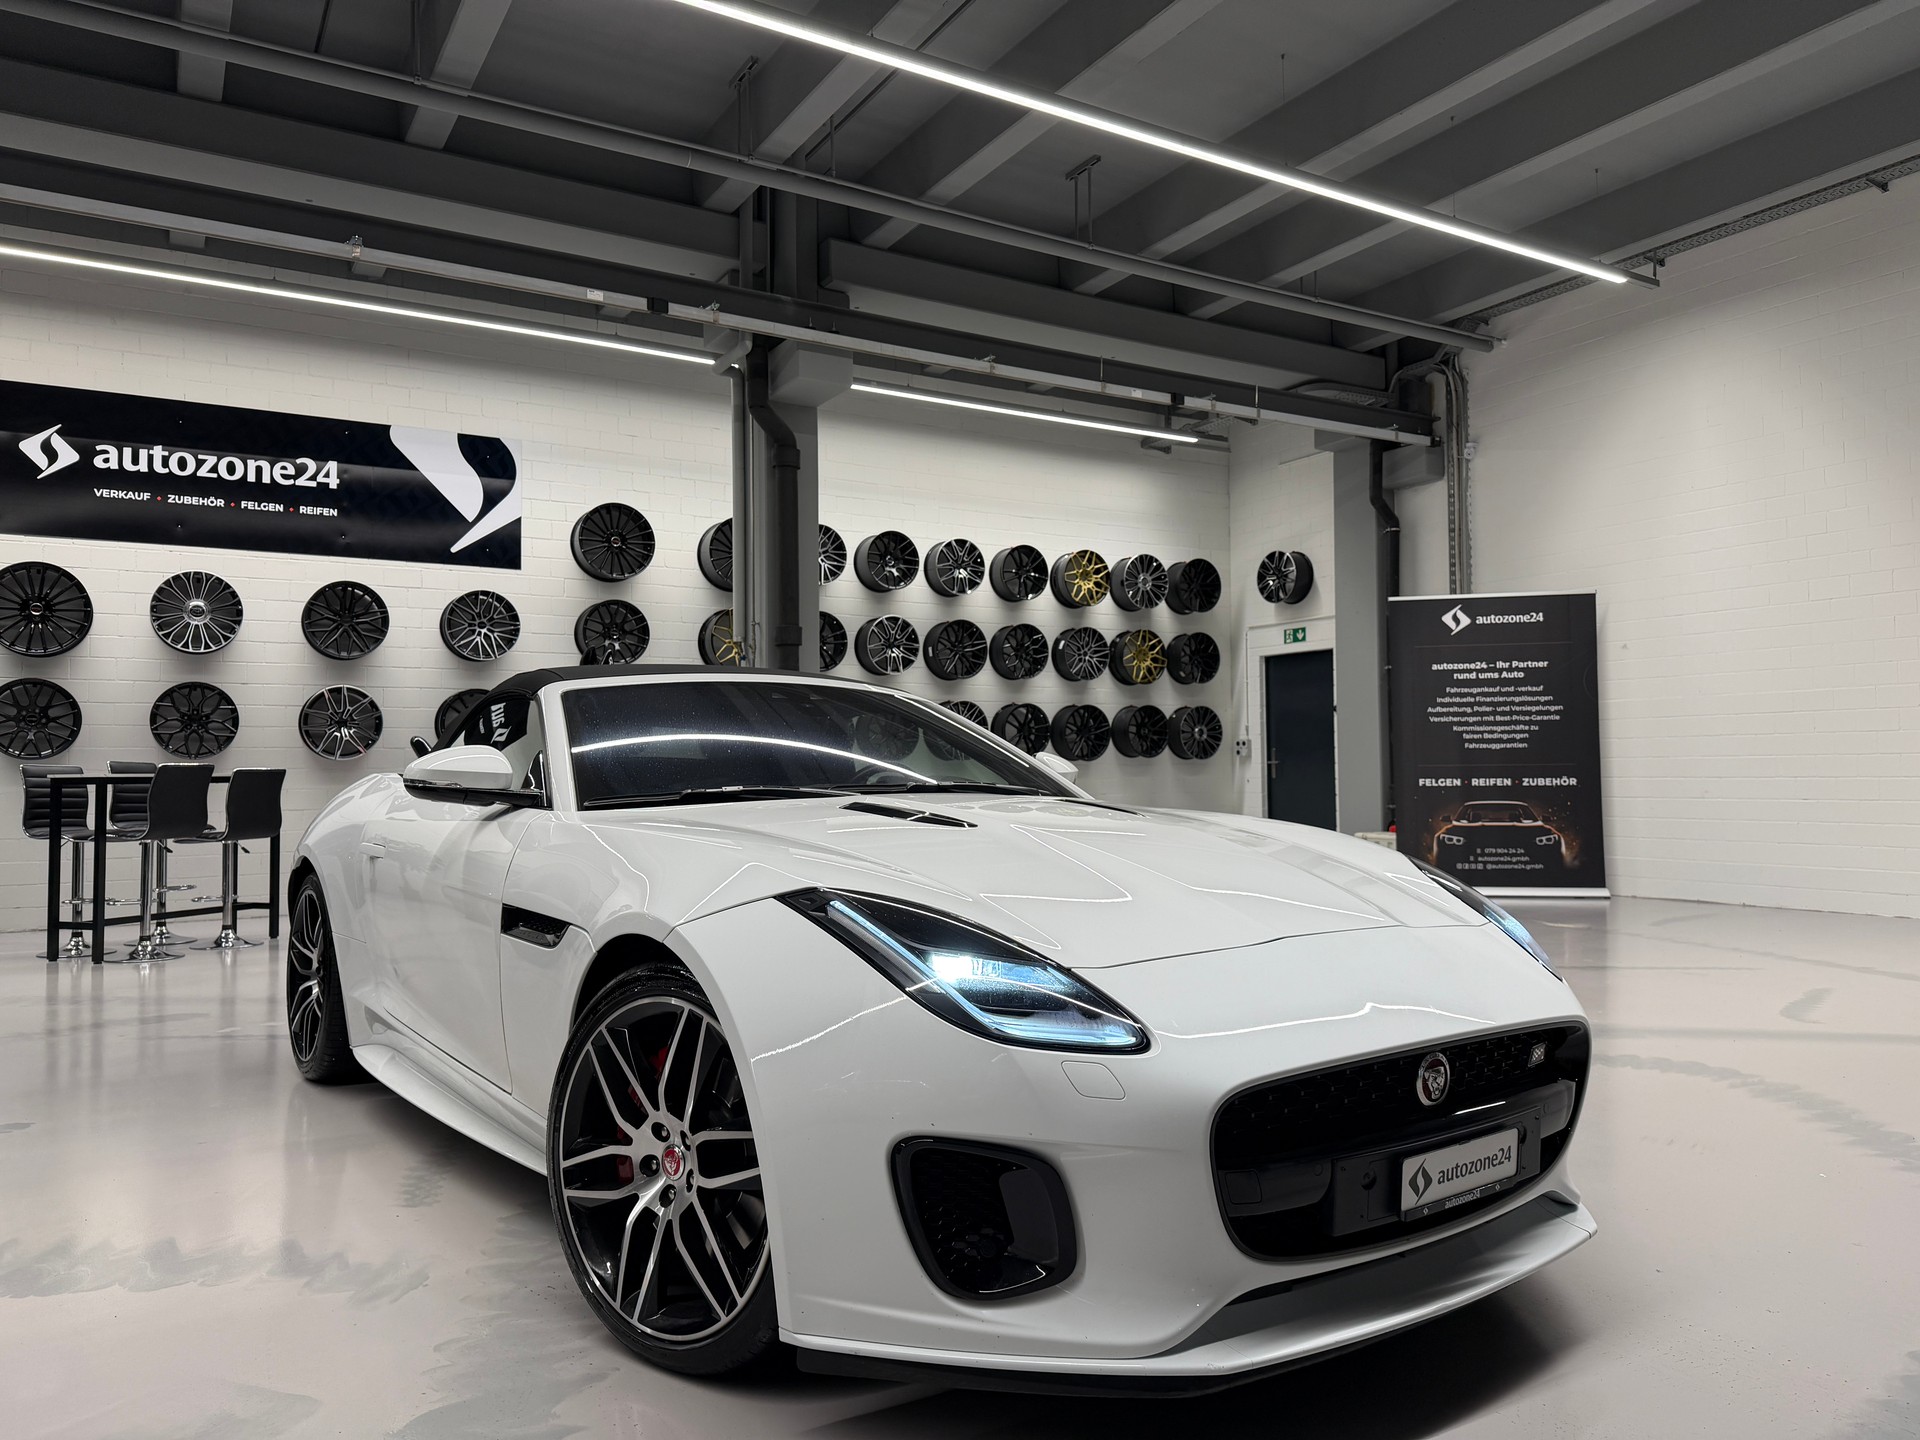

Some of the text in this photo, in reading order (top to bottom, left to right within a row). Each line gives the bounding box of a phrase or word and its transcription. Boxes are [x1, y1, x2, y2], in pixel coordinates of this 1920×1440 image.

[92, 443, 340, 490] autozone24
[93, 487, 338, 518] VERKAUF ZUBEHÖR FELGEN REIFEN
[1475, 612, 1544, 625] autozone24
[1431, 662, 1488, 671] autozone24
[1496, 661, 1510, 669] Ihr
[1512, 660, 1548, 669] Partner
[1453, 671, 1476, 680] rund
[1501, 670, 1525, 679] Auto
[1446, 686, 1500, 694] Fahrzeugankauf
[1476, 694, 1553, 703] Finanzierungslösungen
[1511, 704, 1563, 713] Versiegelungen
[1429, 715, 1481, 723] Versicherungen
[1482, 714, 1494, 722] mit
[1453, 723, 1529, 732] Kommissionsgeschäfte
[1483, 732, 1529, 740] Bedingungen
[1464, 742, 1528, 750] Fahrzeuggarantien
[1418, 776, 1577, 787] FELGEN REIFEN ZUBEHÖR
[1437, 1145, 1512, 1185] autozone24
[1444, 1189, 1481, 1209] autozone24
